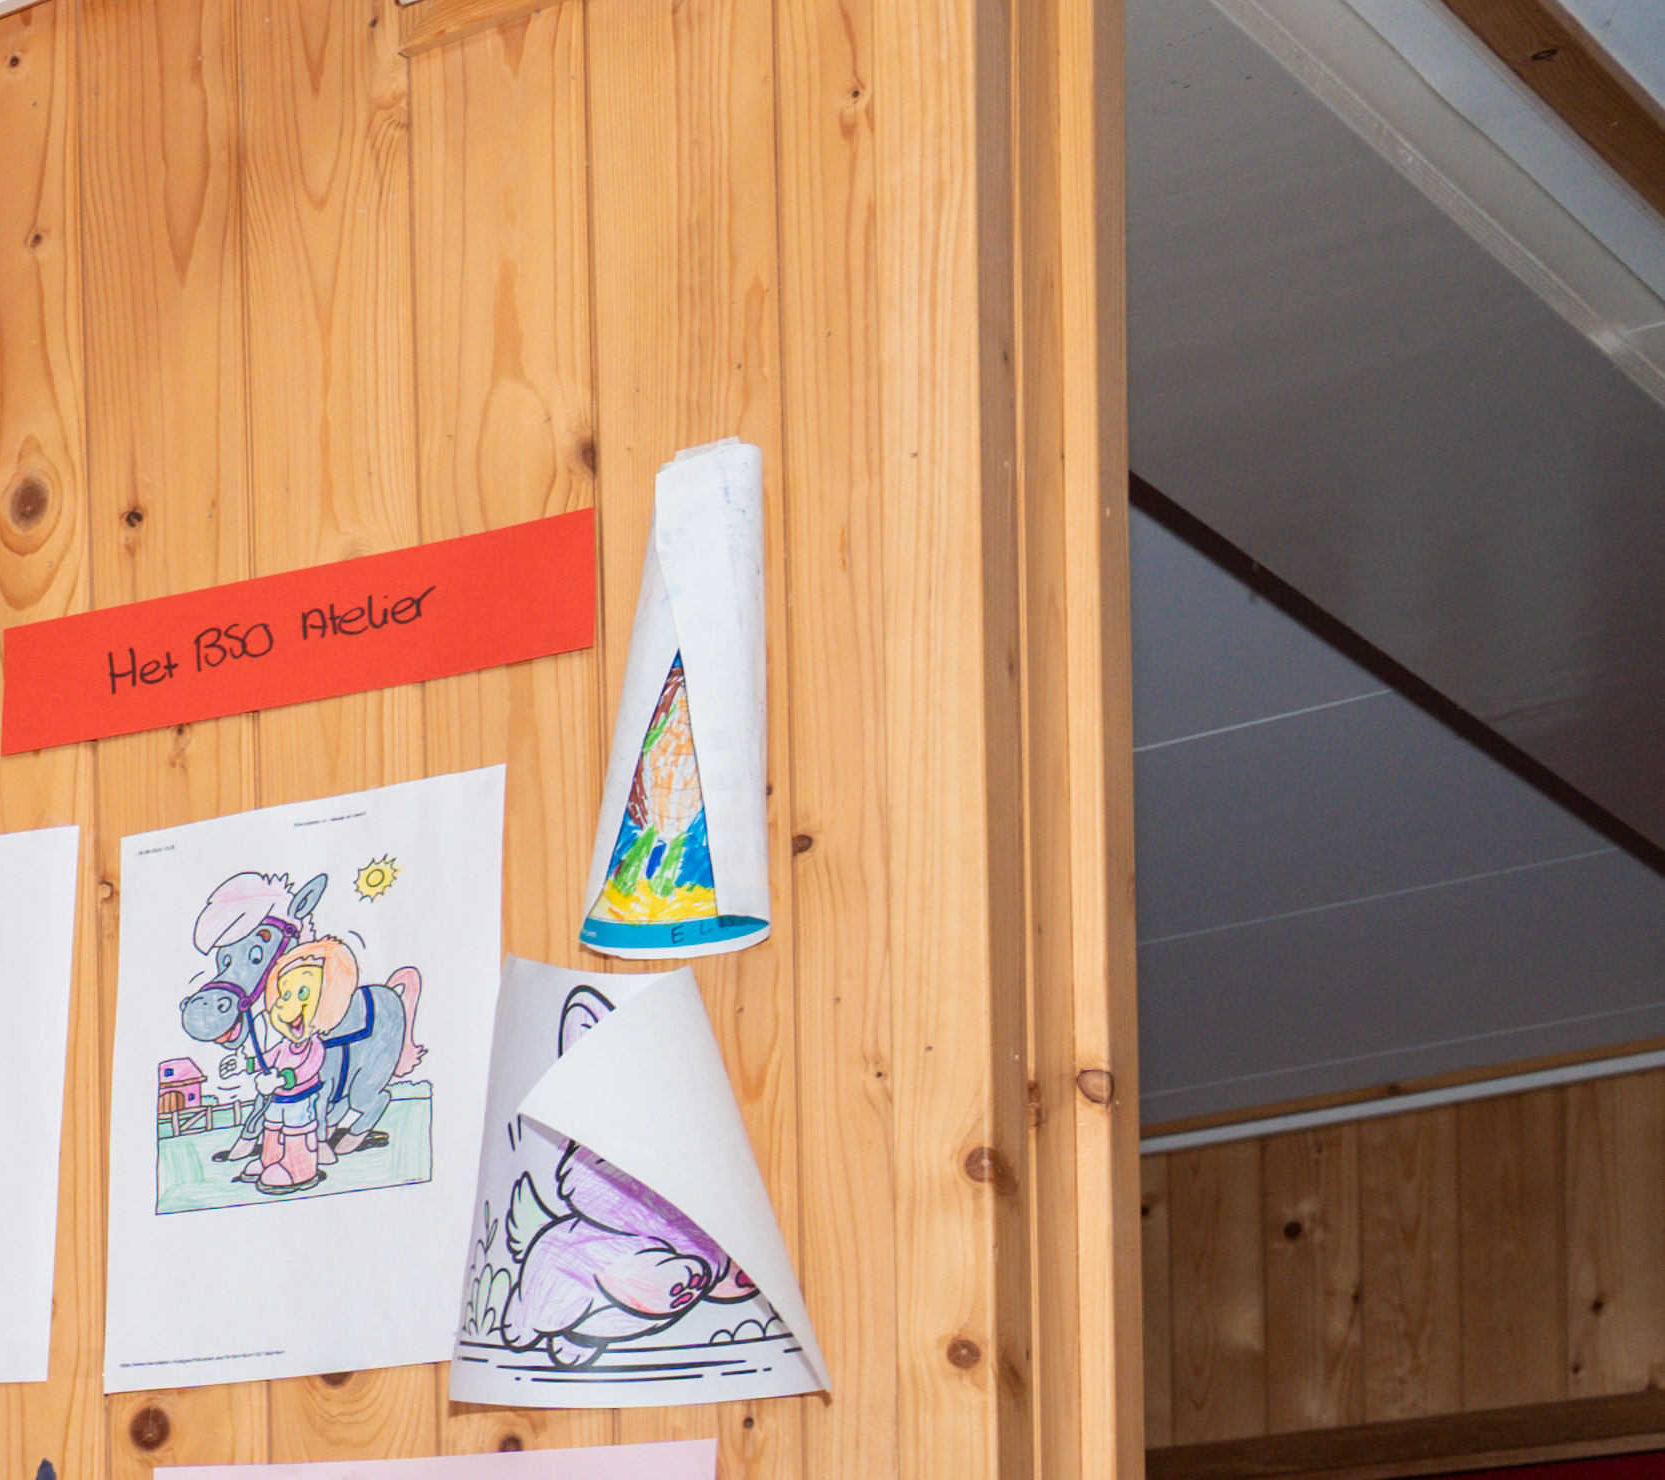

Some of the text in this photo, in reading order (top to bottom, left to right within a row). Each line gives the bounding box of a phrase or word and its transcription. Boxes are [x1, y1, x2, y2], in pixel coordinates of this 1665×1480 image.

[108, 586, 436, 694] Het BSO Atelier
